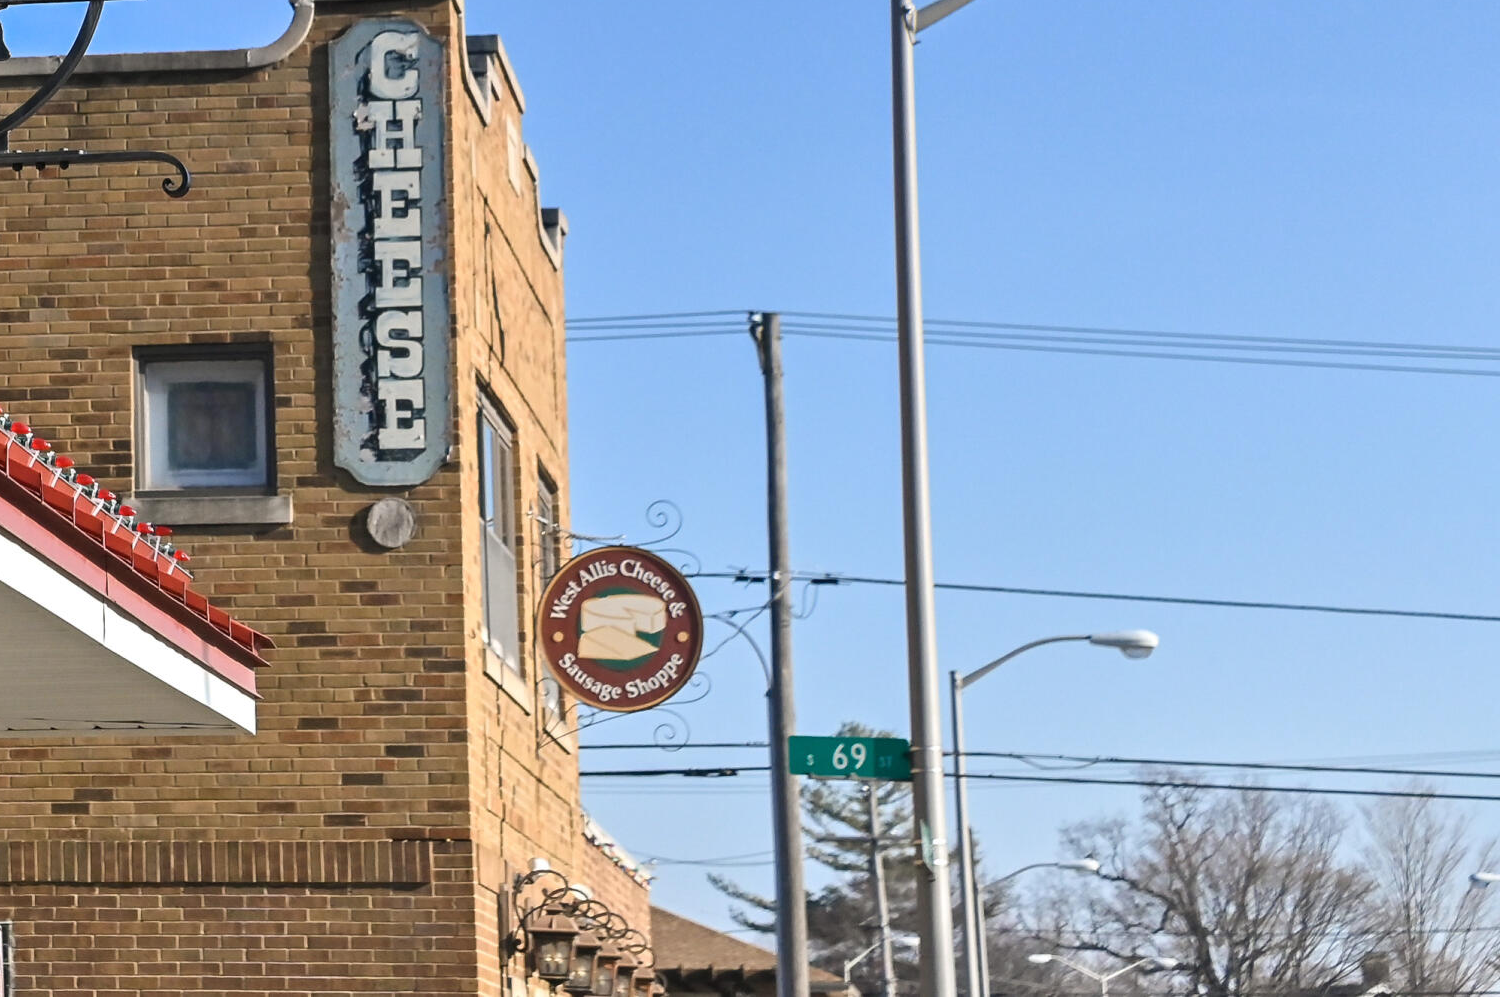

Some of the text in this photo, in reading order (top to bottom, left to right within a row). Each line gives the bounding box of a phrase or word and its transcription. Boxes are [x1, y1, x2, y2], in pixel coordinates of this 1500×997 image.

[368, 32, 426, 450] CHEESE
[550, 559, 687, 619] West Allis Cheese &
[558, 652, 684, 701] Sausage Shoppe
[806, 754, 815, 766] S
[832, 743, 867, 770] 69
